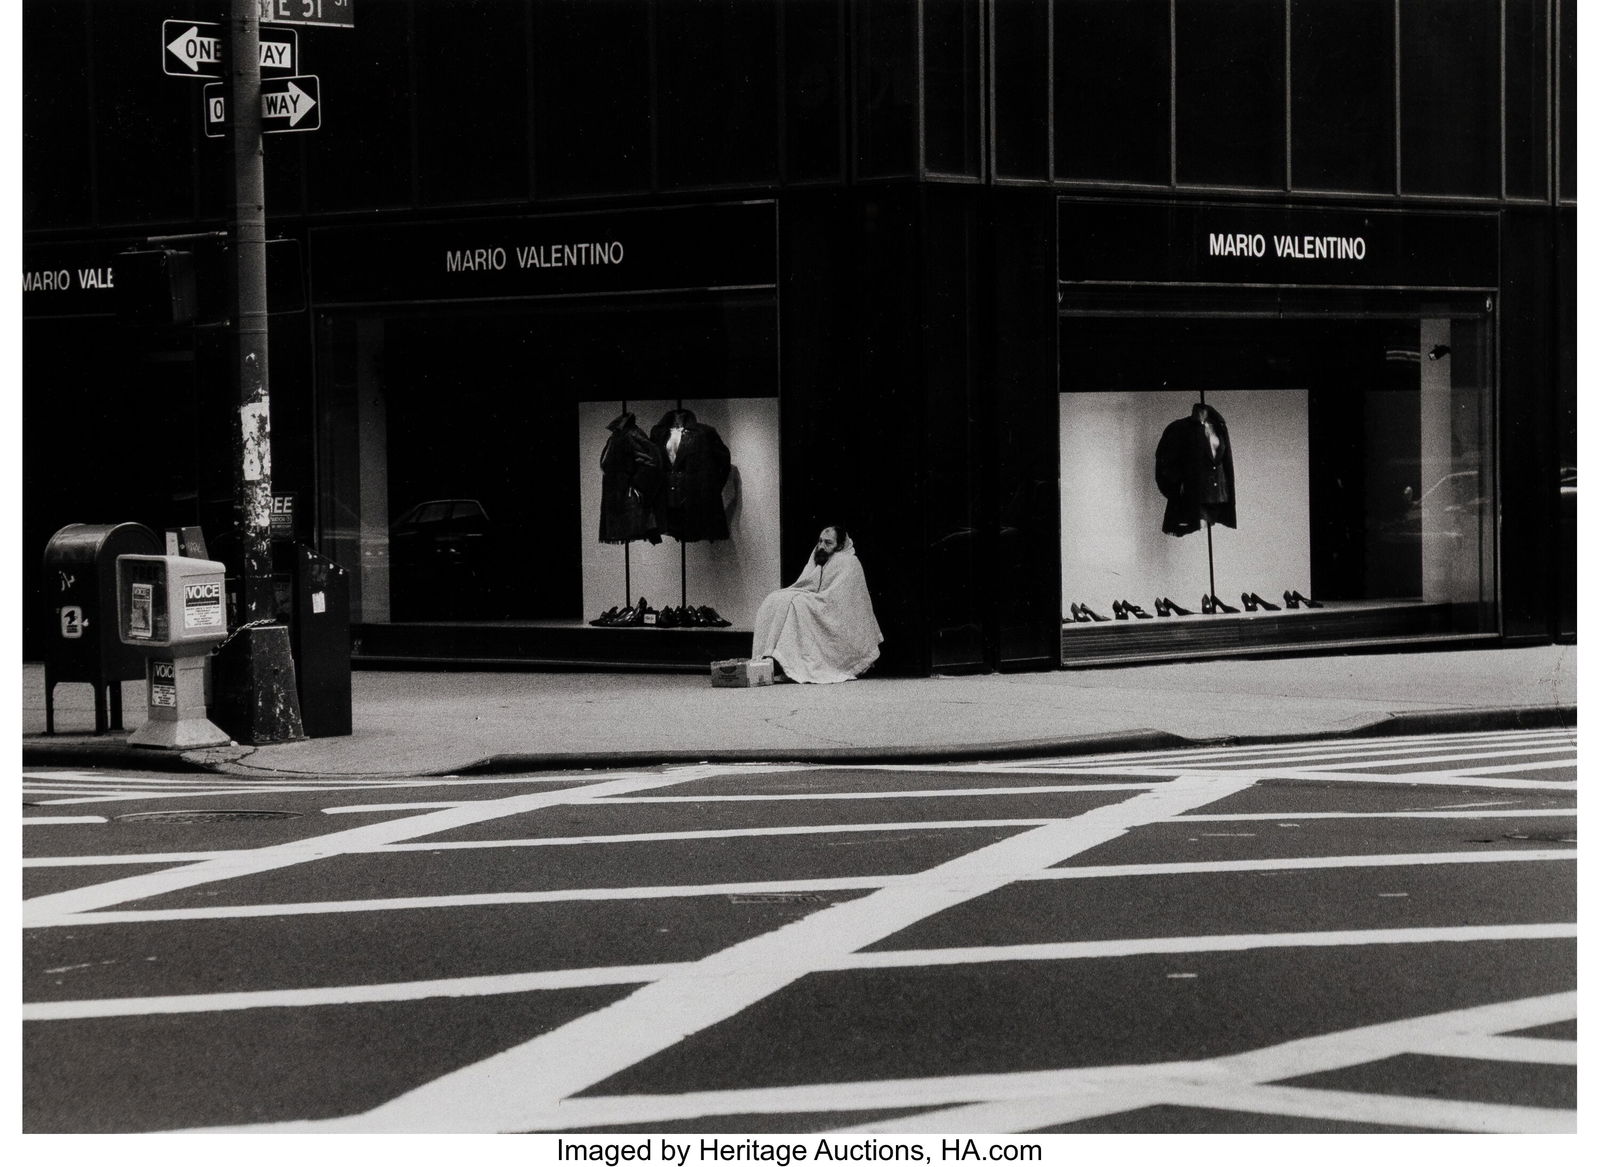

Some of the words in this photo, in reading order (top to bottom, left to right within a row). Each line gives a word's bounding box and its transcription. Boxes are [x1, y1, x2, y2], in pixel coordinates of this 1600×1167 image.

[185, 39, 222, 60] ONE
[260, 44, 287, 65] AY
[265, 94, 300, 115] WAY
[447, 247, 507, 272] MARIO
[516, 241, 624, 269] VALENTINO
[1209, 233, 1266, 258] MARIO
[1273, 235, 1366, 260] VALENTINO
[23, 269, 71, 291] MARIO
[186, 584, 220, 599] VOICE
